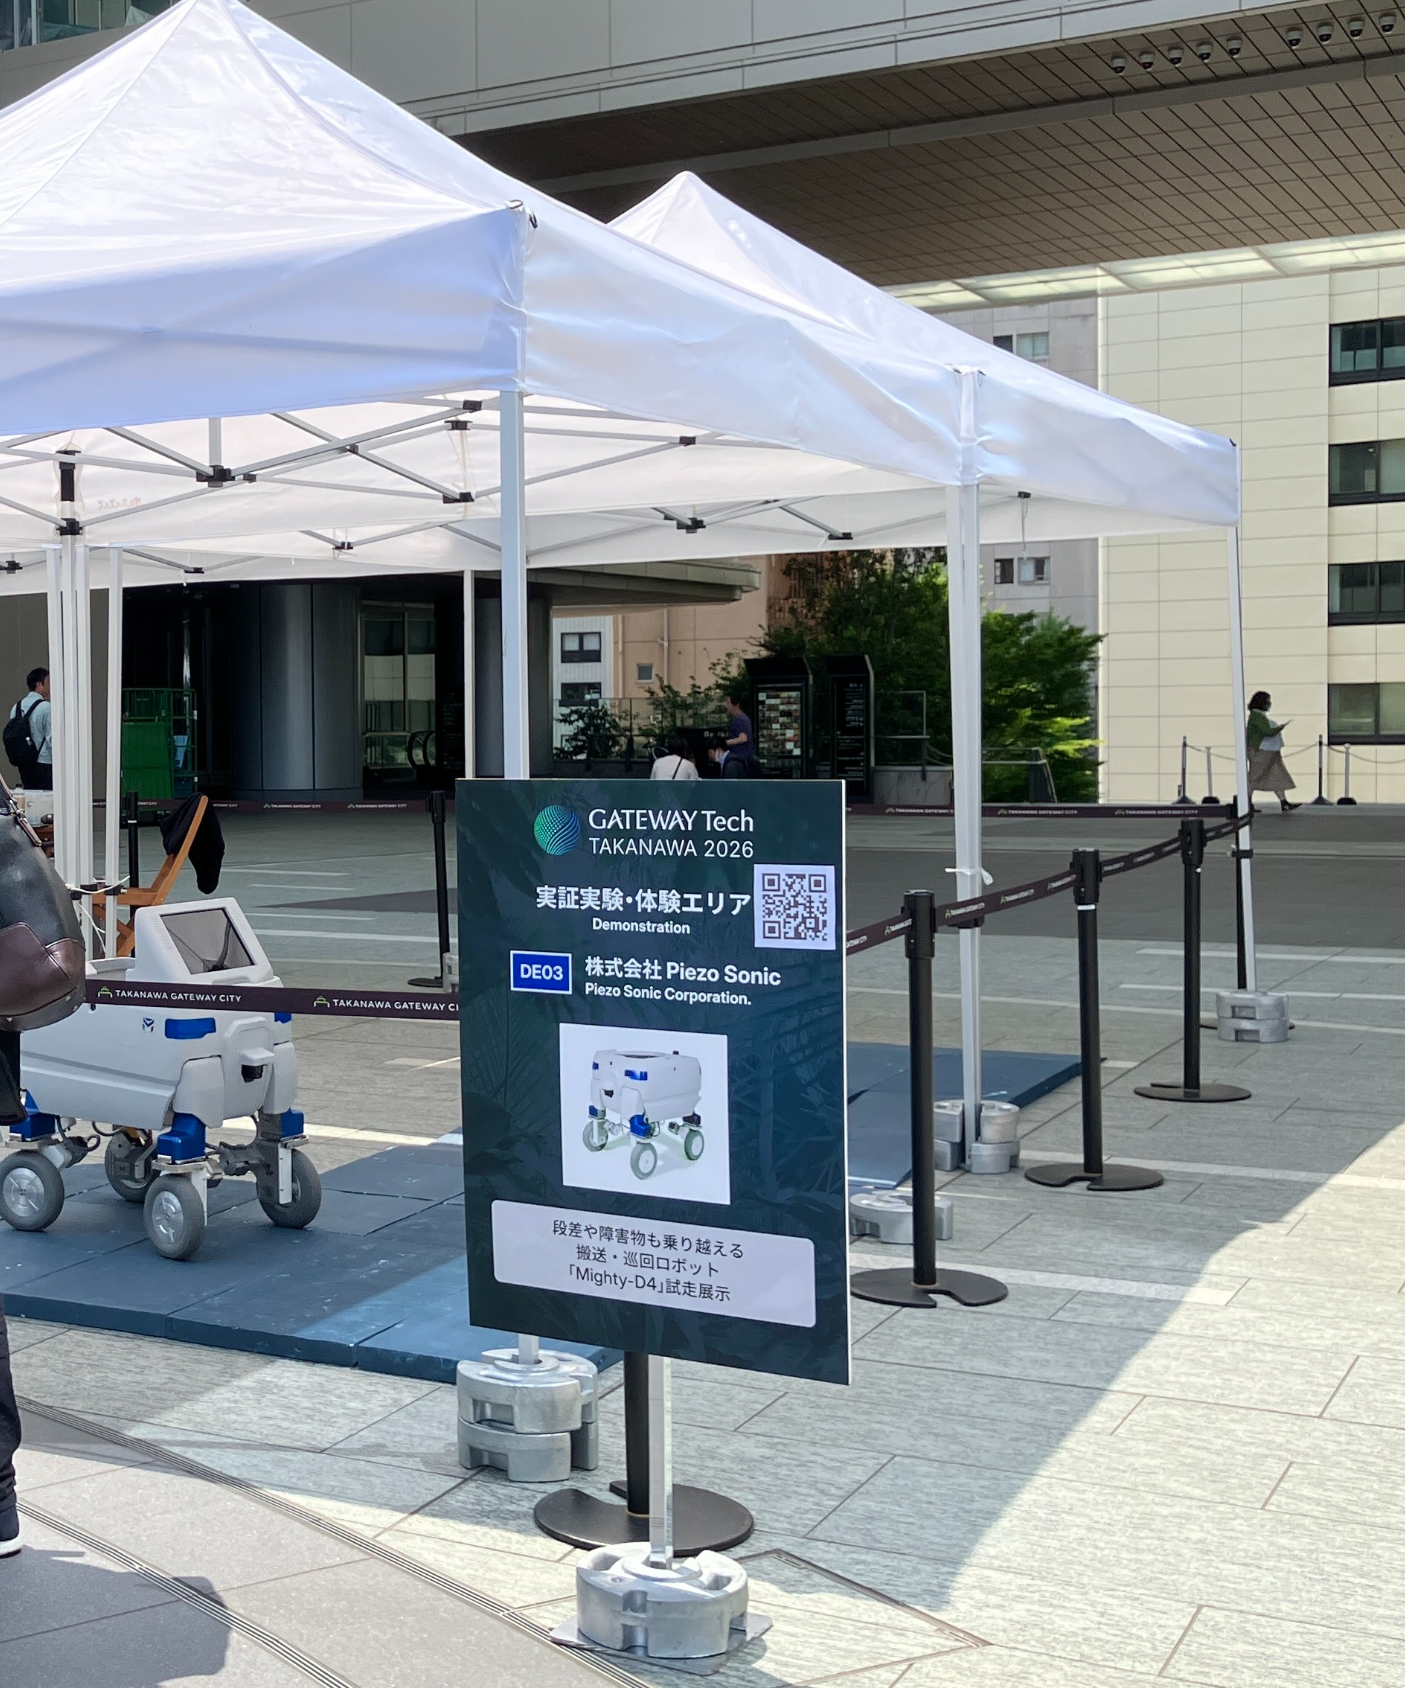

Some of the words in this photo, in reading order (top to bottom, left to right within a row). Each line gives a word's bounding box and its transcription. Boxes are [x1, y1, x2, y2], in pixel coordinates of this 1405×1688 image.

[588, 808, 698, 831] GATEWAY
[701, 809, 754, 832] Tech
[588, 838, 698, 857] TAKANAWA
[704, 840, 754, 858] 2026
[536, 885, 751, 916] 実証実験・体験エリア
[593, 917, 691, 934] Demonstration
[520, 963, 563, 981] DE03
[585, 956, 662, 980] 株式会社
[666, 962, 719, 983] Piezo
[724, 965, 782, 986] Sonic
[115, 989, 169, 1000] TAKANAWA
[170, 992, 217, 1002] GATEWAY
[219, 994, 242, 1003] CITY
[333, 999, 391, 1009] TAKANAWA
[394, 1001, 446, 1011] GATEWAY
[585, 982, 621, 997] Piezo
[623, 984, 661, 1000] Sonic
[664, 989, 752, 1006] Corporation.
[552, 1219, 744, 1259] 段差や障害物も乗り越える
[576, 1243, 719, 1276] 搬送・巡回ロボット
[568, 1264, 731, 1302] 「Mighty-D4」試走展示
